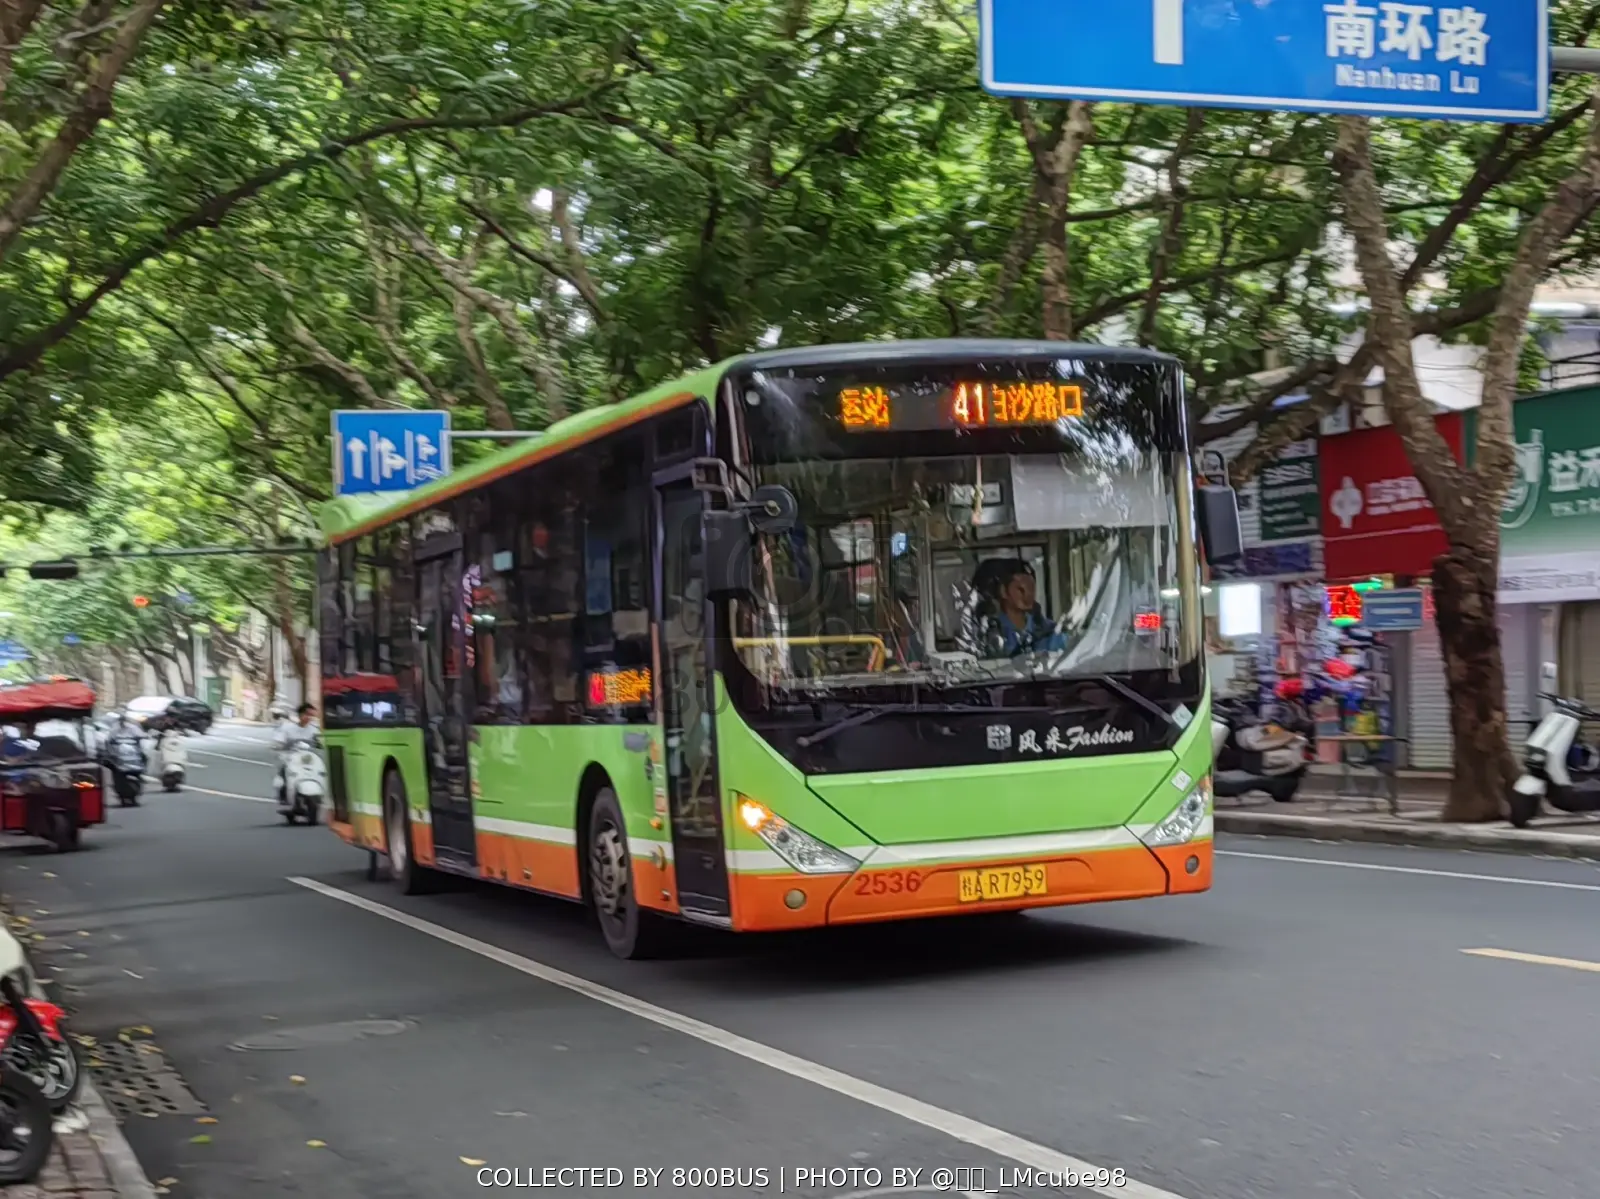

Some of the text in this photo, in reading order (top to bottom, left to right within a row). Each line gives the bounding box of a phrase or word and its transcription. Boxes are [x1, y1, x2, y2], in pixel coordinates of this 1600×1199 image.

[1322, 0, 1491, 66] 南环路
[1335, 63, 1480, 94] Nanhuan Lu
[954, 382, 986, 425] 41
[1018, 725, 1067, 754] 风采
[1066, 722, 1135, 751] Fashion
[854, 870, 923, 896] 2536
